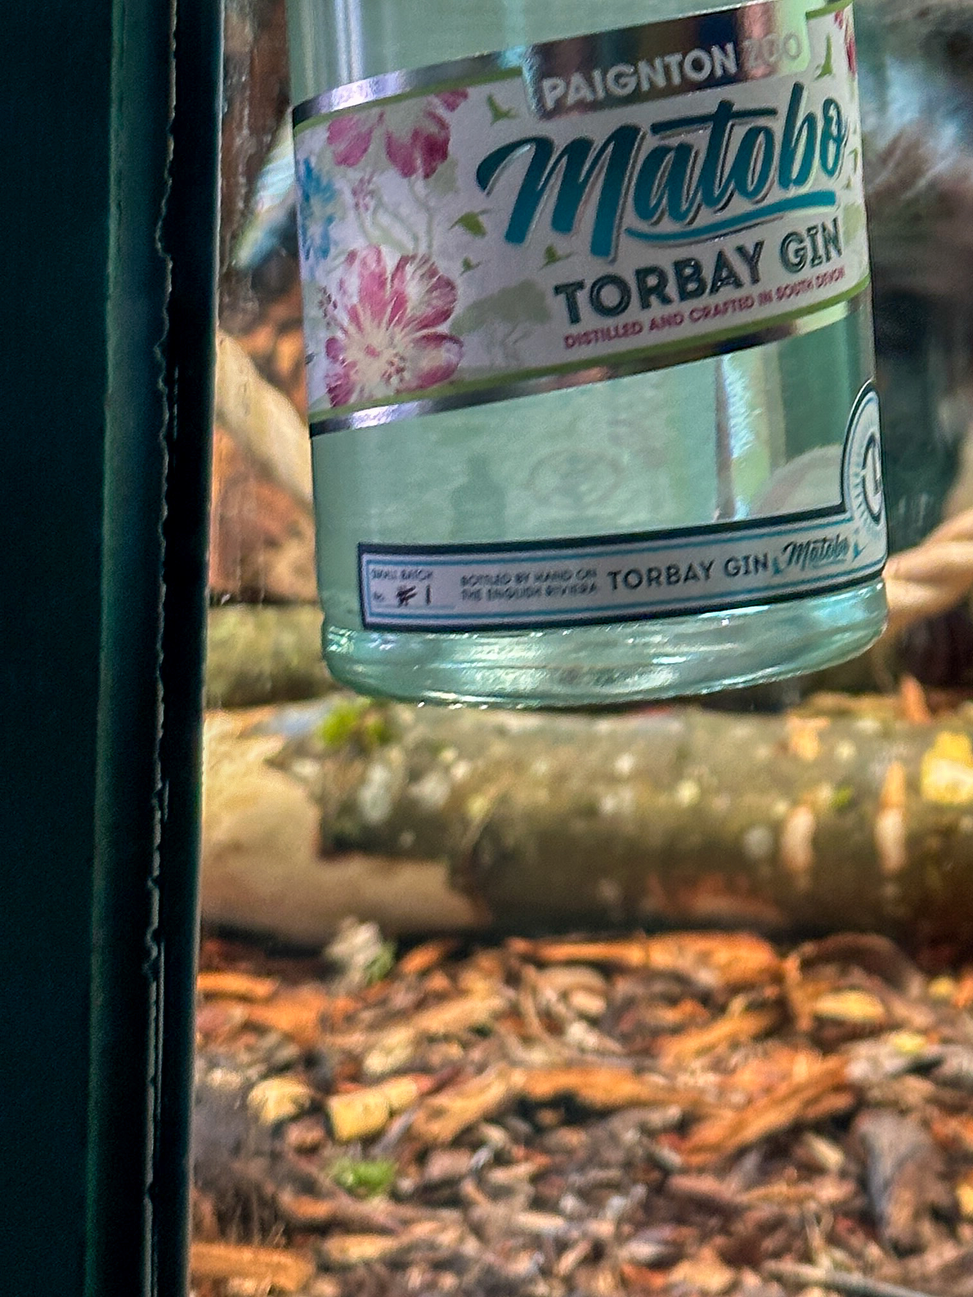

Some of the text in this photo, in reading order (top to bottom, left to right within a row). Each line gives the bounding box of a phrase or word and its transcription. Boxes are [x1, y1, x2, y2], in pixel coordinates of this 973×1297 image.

[541, 33, 802, 111] PAIGNTON ZOO
[476, 81, 847, 259] Matobo
[553, 216, 844, 325] TORBAY GIN
[563, 266, 846, 350] DISTILLED AND CRAFTED IN SOUTH DEVON
[401, 568, 434, 581] BATCH
[460, 567, 598, 587] BOTTLED BY HAND ON
[461, 582, 598, 601] THE ENGLISH RIVIERA
[607, 552, 770, 591] TORBAY GIN
